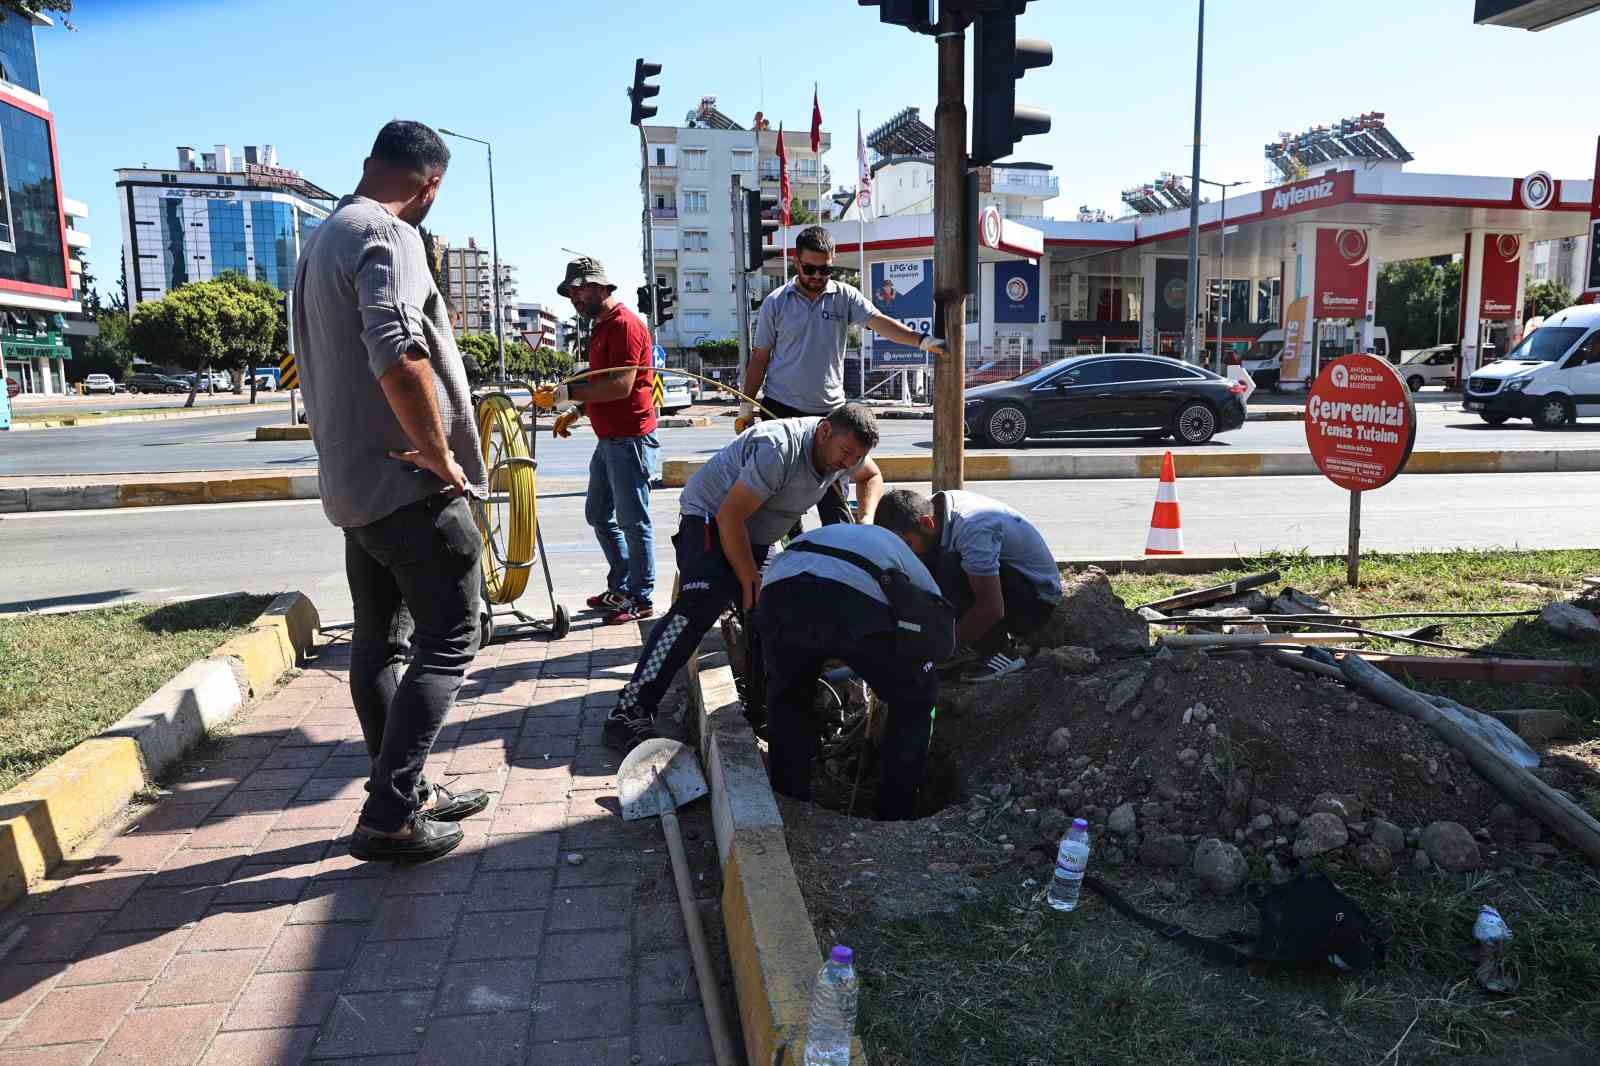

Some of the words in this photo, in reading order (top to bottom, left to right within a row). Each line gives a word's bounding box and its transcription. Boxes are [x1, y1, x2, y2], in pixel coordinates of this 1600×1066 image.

[1272, 179, 1335, 211] Aytemiz
[1284, 320, 1299, 359] UTTS
[1309, 395, 1404, 426] Çevremizi
[1320, 421, 1353, 439] Temiz
[1356, 425, 1399, 445] Tutalım
